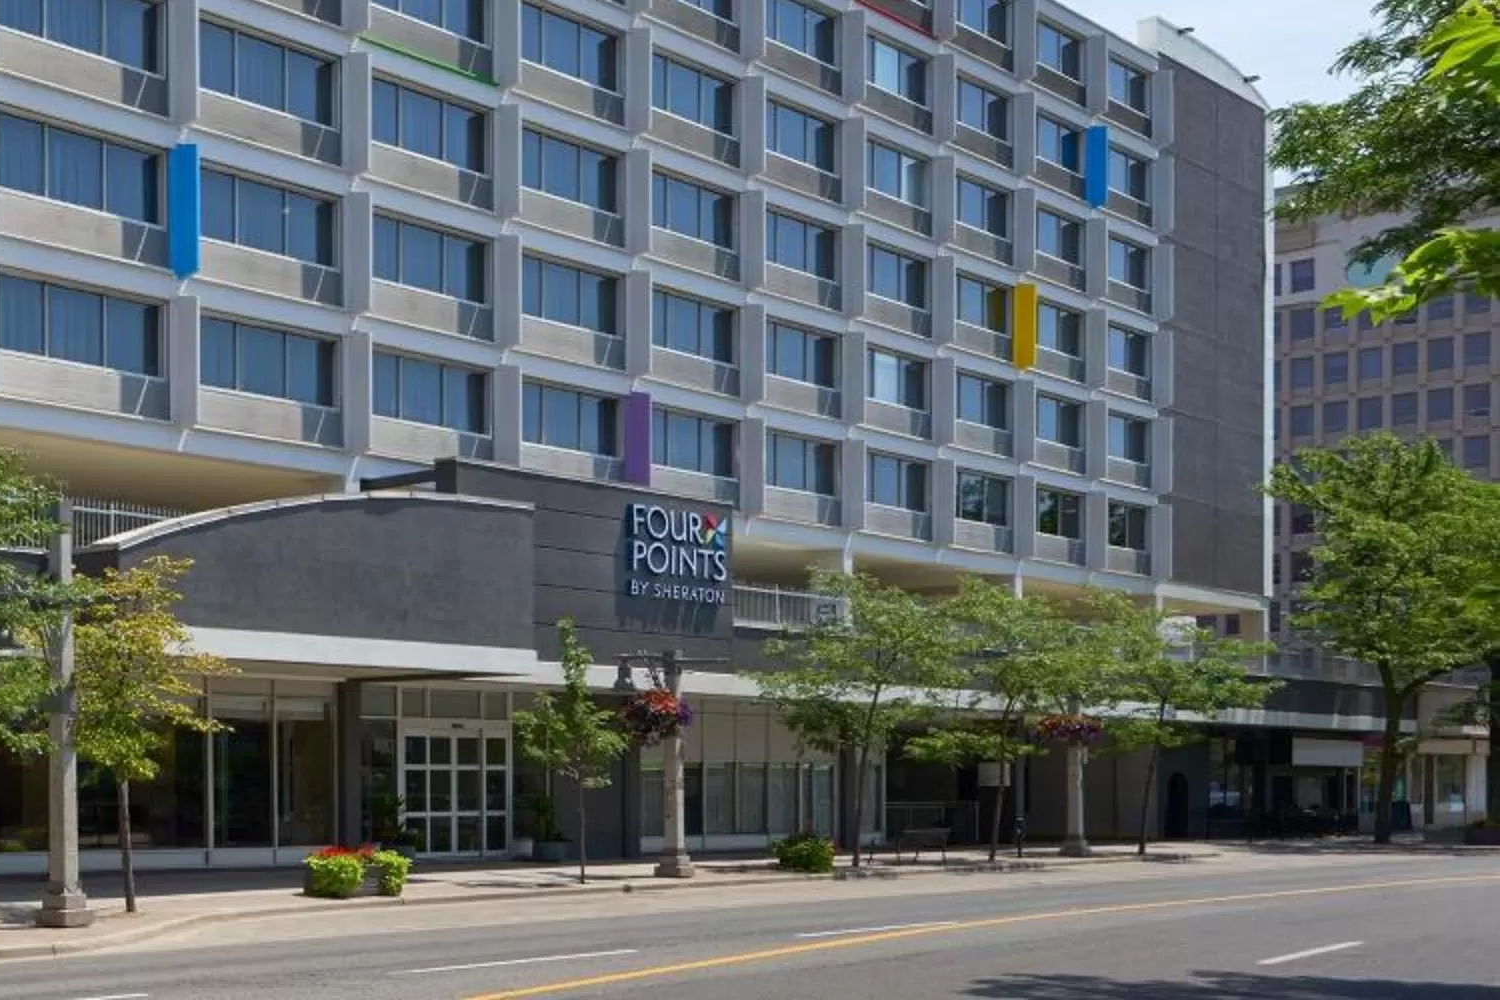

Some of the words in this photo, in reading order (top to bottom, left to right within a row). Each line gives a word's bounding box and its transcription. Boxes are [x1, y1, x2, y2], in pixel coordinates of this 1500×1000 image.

[633, 503, 705, 545] FOUR
[633, 540, 727, 581] POINTS
[631, 580, 649, 595] BY
[654, 583, 725, 603] SHERATON
